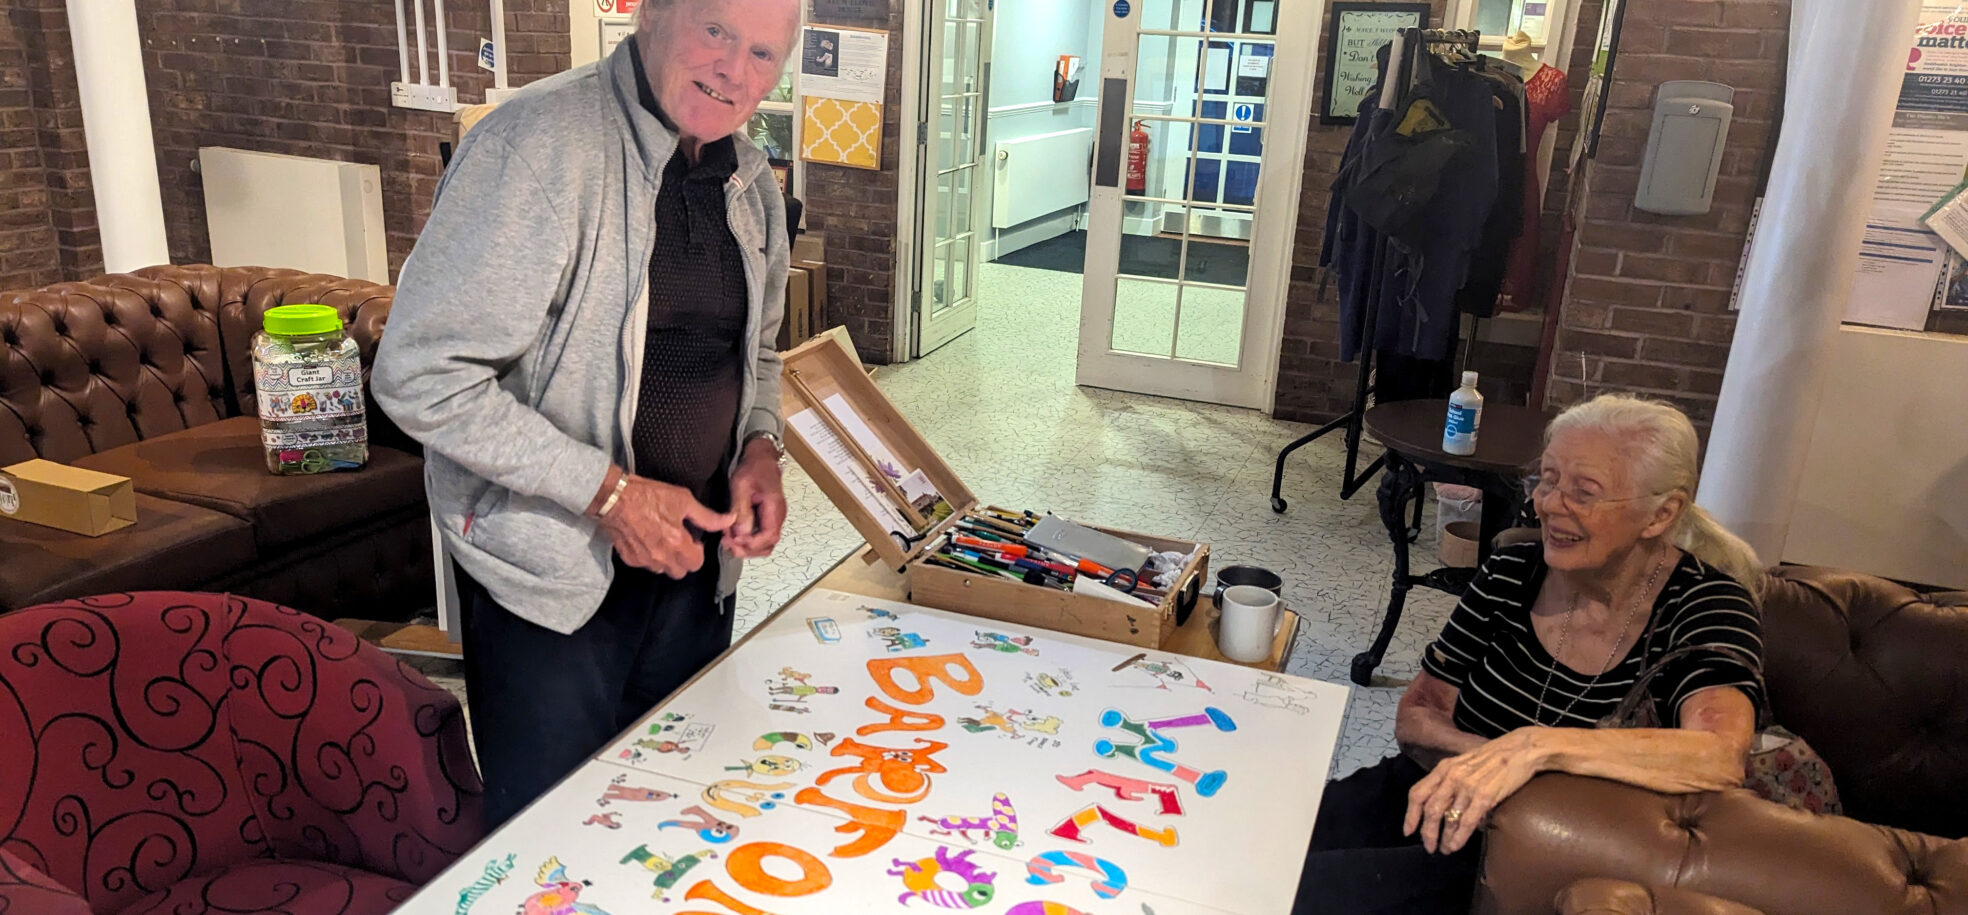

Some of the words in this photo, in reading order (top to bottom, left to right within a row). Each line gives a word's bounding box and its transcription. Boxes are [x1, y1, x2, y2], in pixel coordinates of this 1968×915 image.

[1347, 39, 1365, 47] BUT
[1348, 50, 1375, 63] Don't
[1340, 71, 1372, 85] Wishing
[1918, 75, 1941, 83] 01273
[1344, 85, 1365, 96] Well
[618, 730, 836, 905] COURT
[887, 792, 1025, 909] TO
